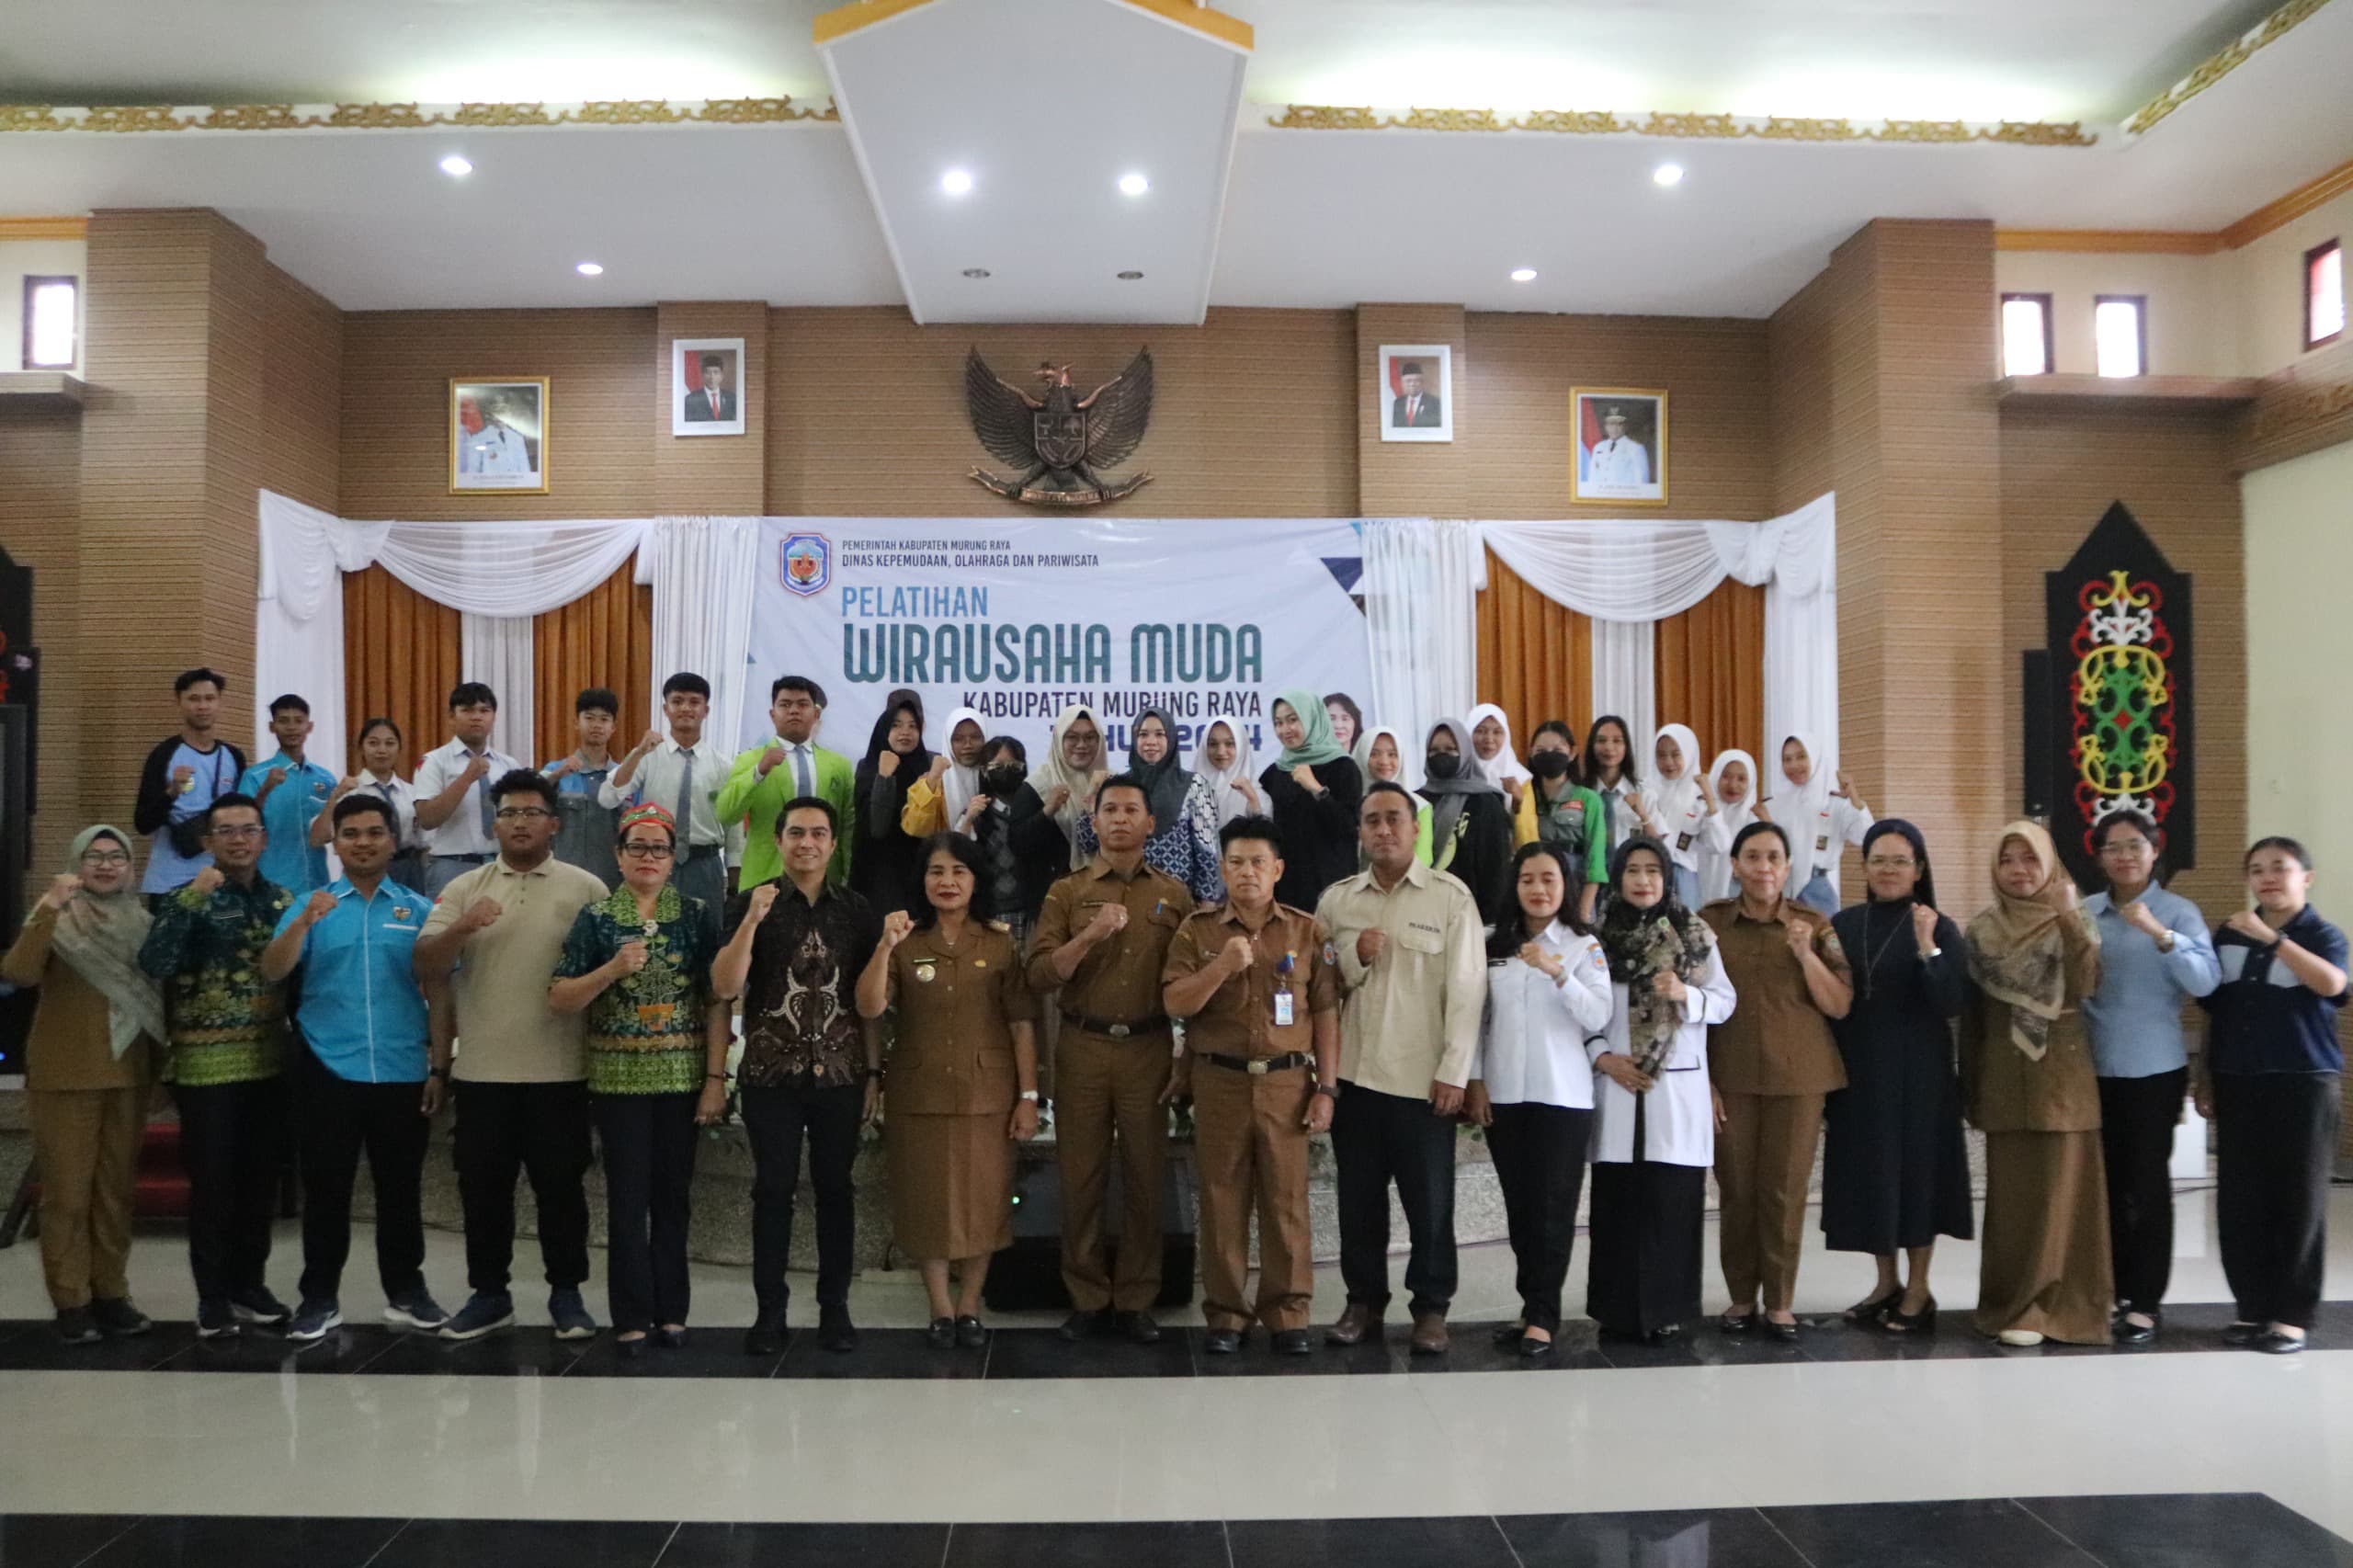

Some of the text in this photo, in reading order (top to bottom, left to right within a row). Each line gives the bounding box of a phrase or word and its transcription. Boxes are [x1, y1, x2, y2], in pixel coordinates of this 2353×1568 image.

[842, 540, 1011, 551] PEMERINTAH KABUPATEN MURUNG RAYA
[842, 554, 1099, 569] DINAS KEPEMUDAAN, OLAHRAGA DAN PARIWISATA
[841, 585, 988, 618] PELATIHAN
[843, 622, 1263, 684] WIRAUSAHA MUDA
[963, 690, 1262, 718] KABUPATEN MURUNG RAYA
